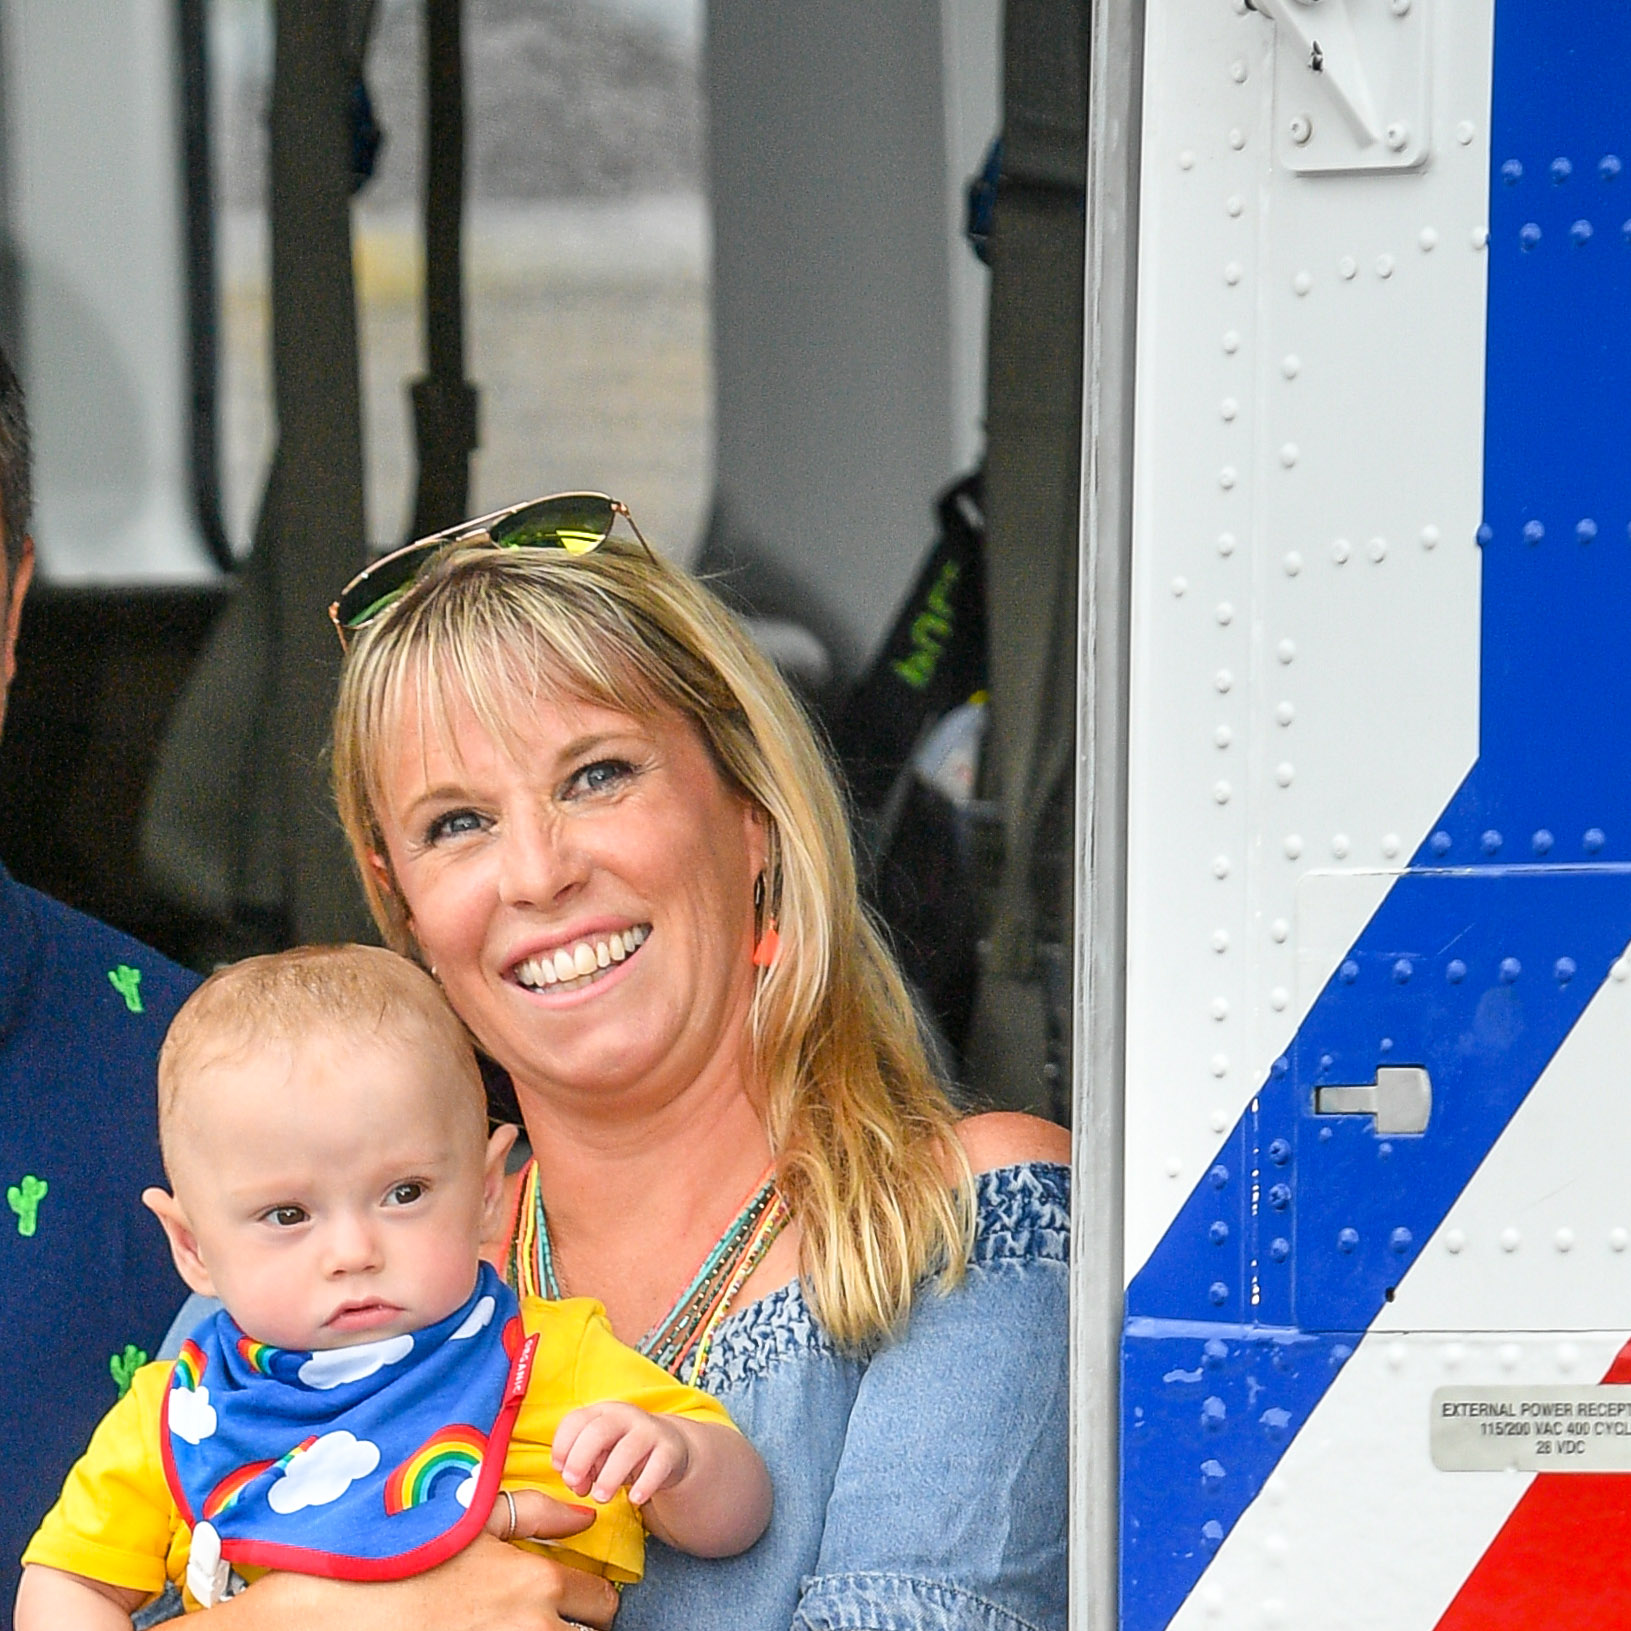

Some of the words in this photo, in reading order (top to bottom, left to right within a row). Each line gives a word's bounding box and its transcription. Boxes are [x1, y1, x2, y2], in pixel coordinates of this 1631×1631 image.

[512, 1339, 533, 1394] ORGANIC
[1441, 1402, 1517, 1417] EXTERNAL
[1521, 1402, 1574, 1417] POWER
[1480, 1421, 1532, 1436] 115/200
[1535, 1421, 1563, 1436] VAC
[1566, 1421, 1591, 1436] 400
[1536, 1440, 1552, 1455] 28
[1556, 1440, 1585, 1455] VDC
